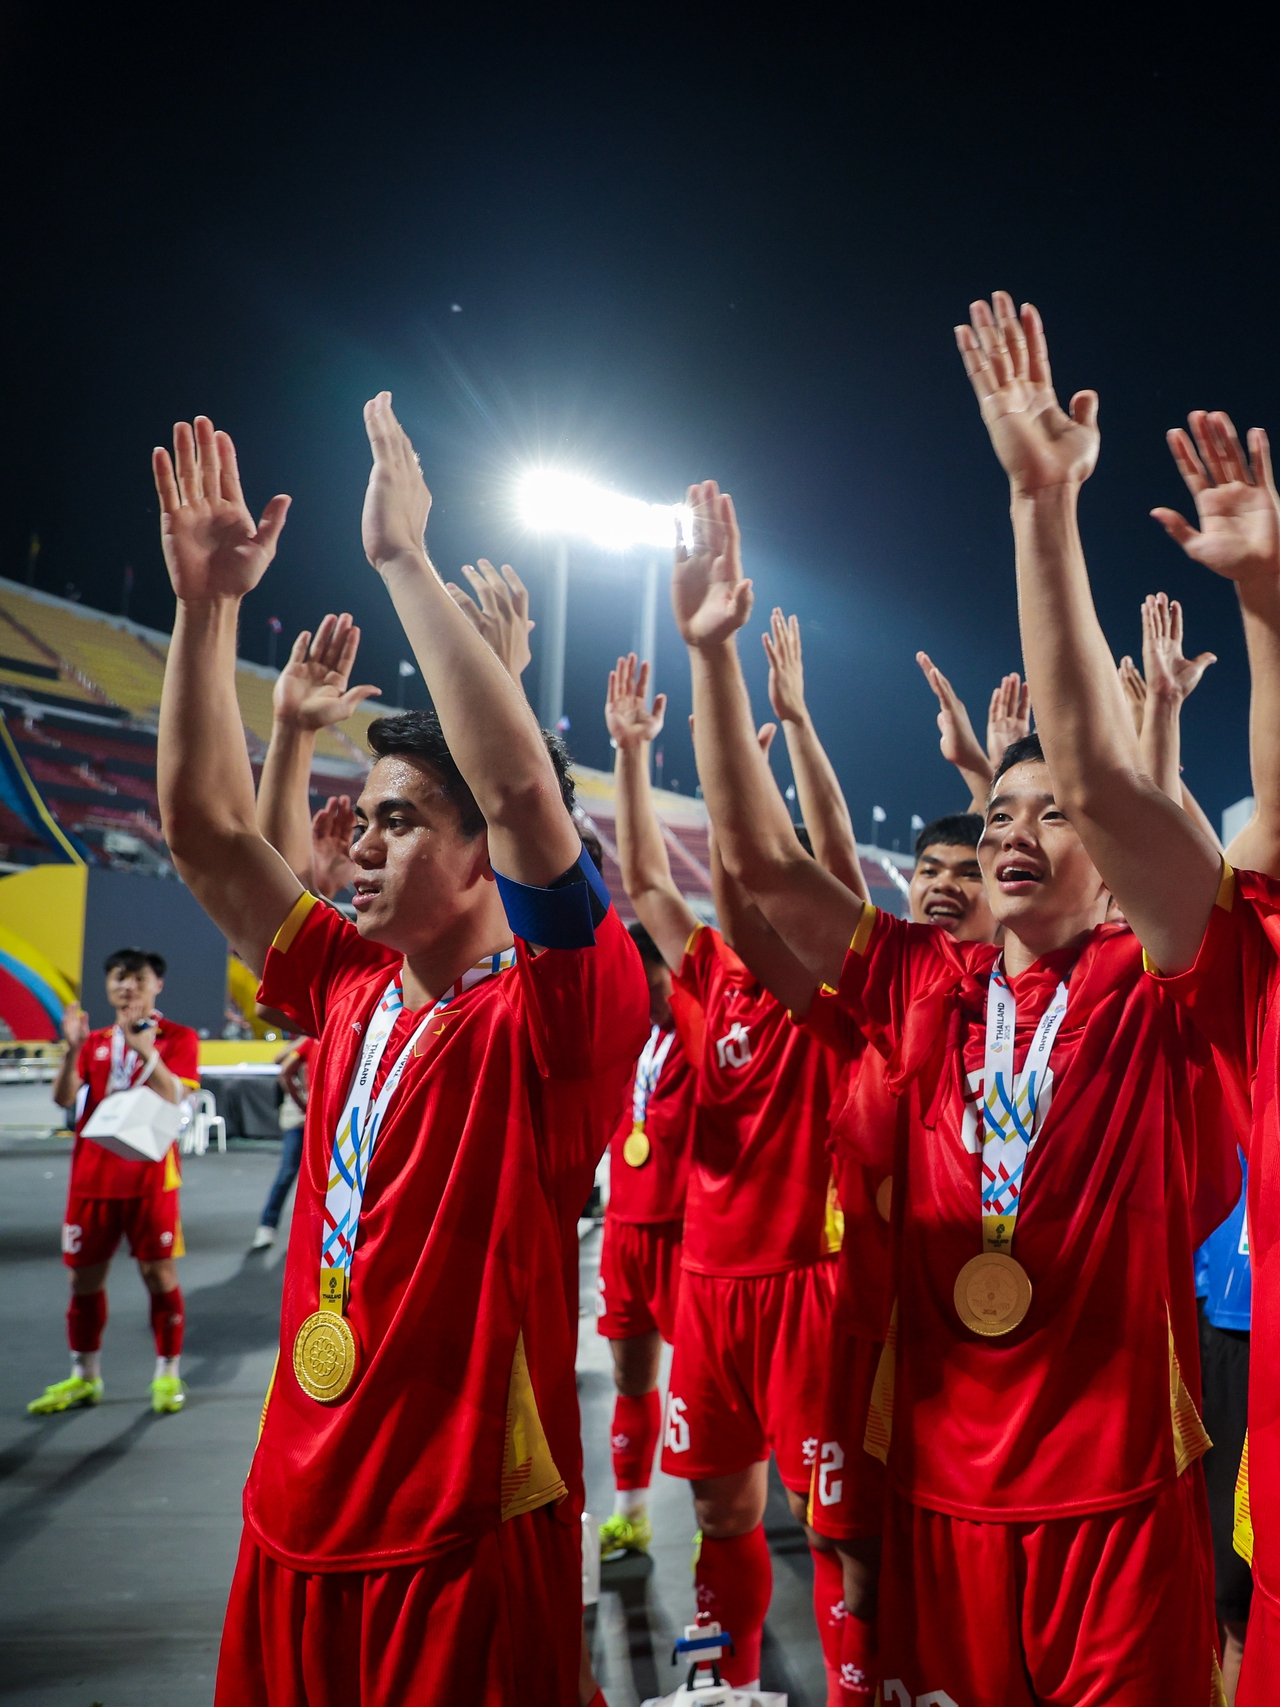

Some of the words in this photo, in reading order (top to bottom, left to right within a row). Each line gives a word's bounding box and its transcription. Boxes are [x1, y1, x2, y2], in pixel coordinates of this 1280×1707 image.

[996, 1002, 1005, 1040] THAILAND
[1038, 1014, 1058, 1052] THAILAND
[360, 1044, 378, 1086] THAILAND
